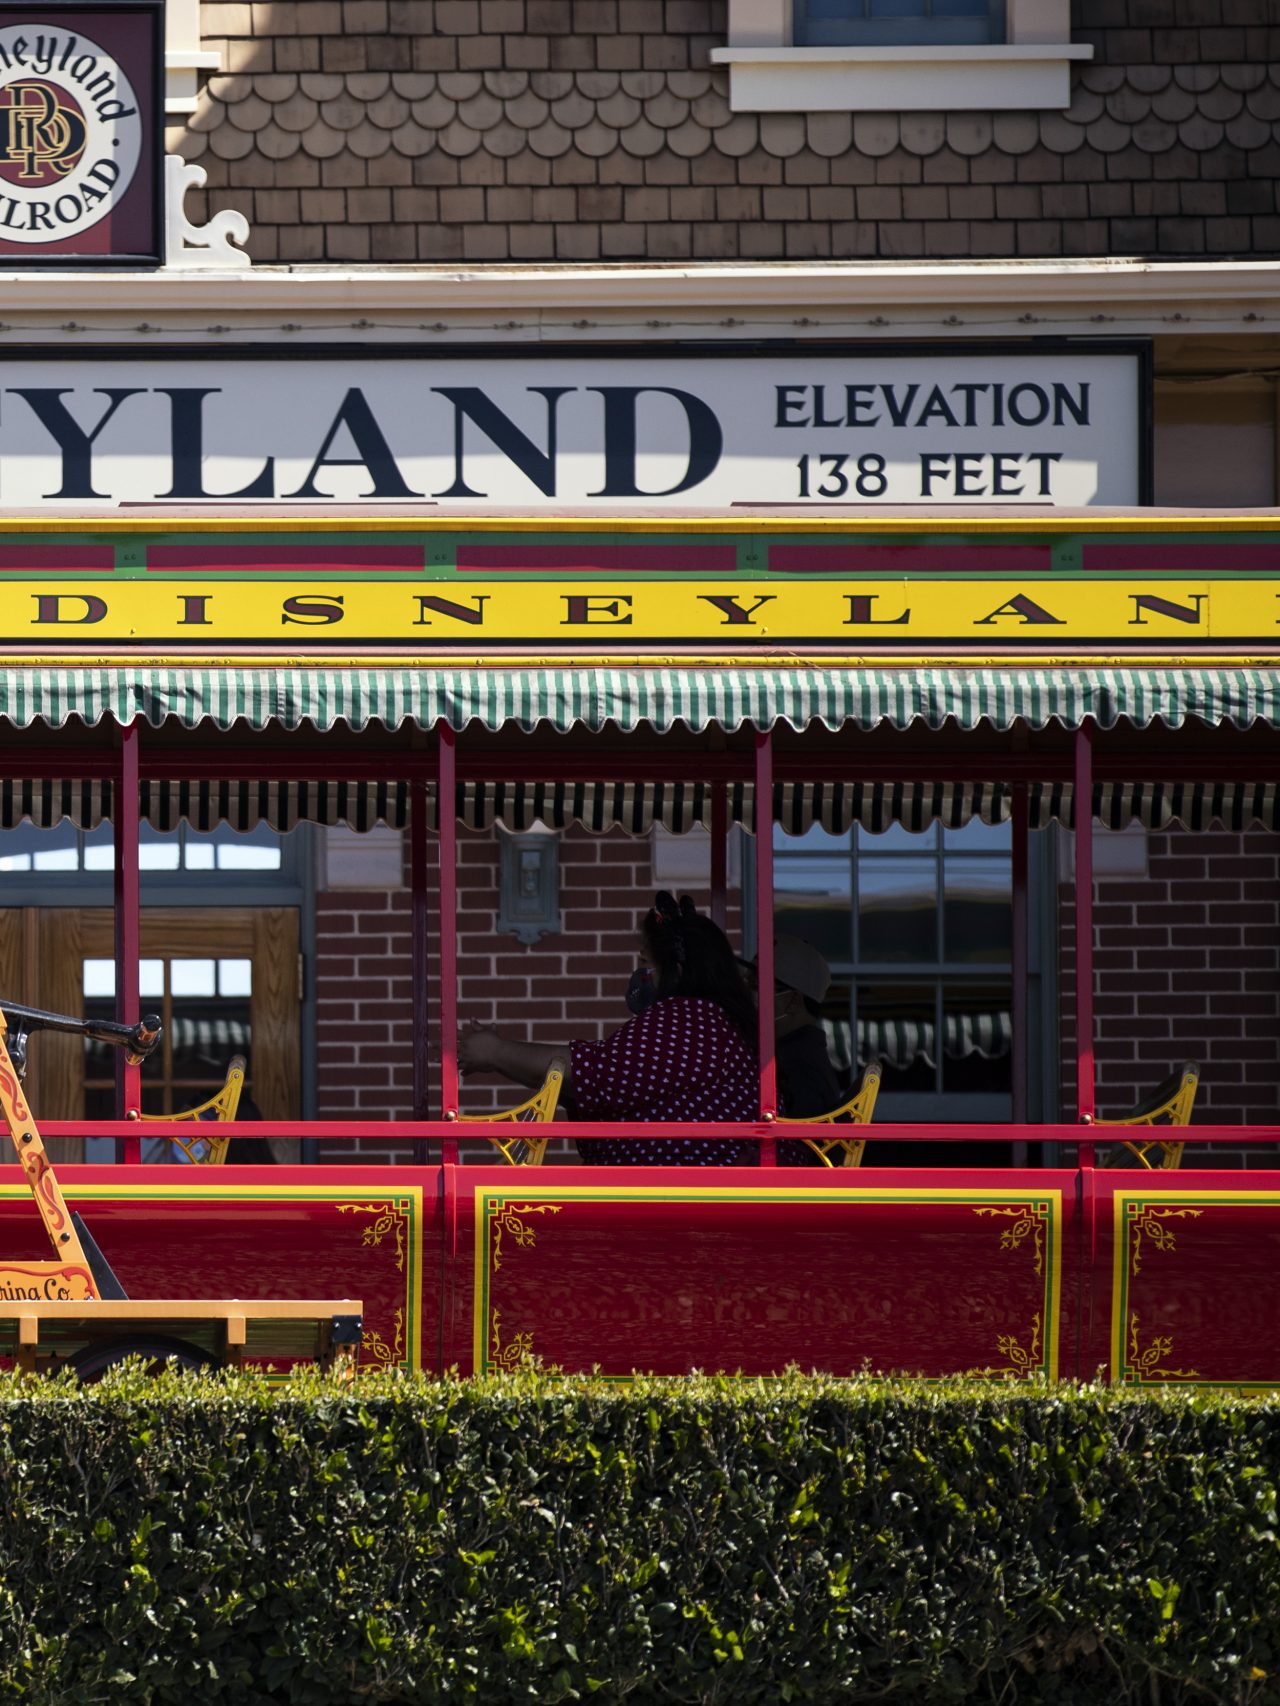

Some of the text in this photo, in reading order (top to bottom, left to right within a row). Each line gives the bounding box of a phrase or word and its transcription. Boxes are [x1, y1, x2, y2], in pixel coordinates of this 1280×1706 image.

[773, 381, 1092, 429] ELEVATION
[796, 452, 1064, 497] 138 FEET
[29, 592, 1280, 626] DISNEYLAN
